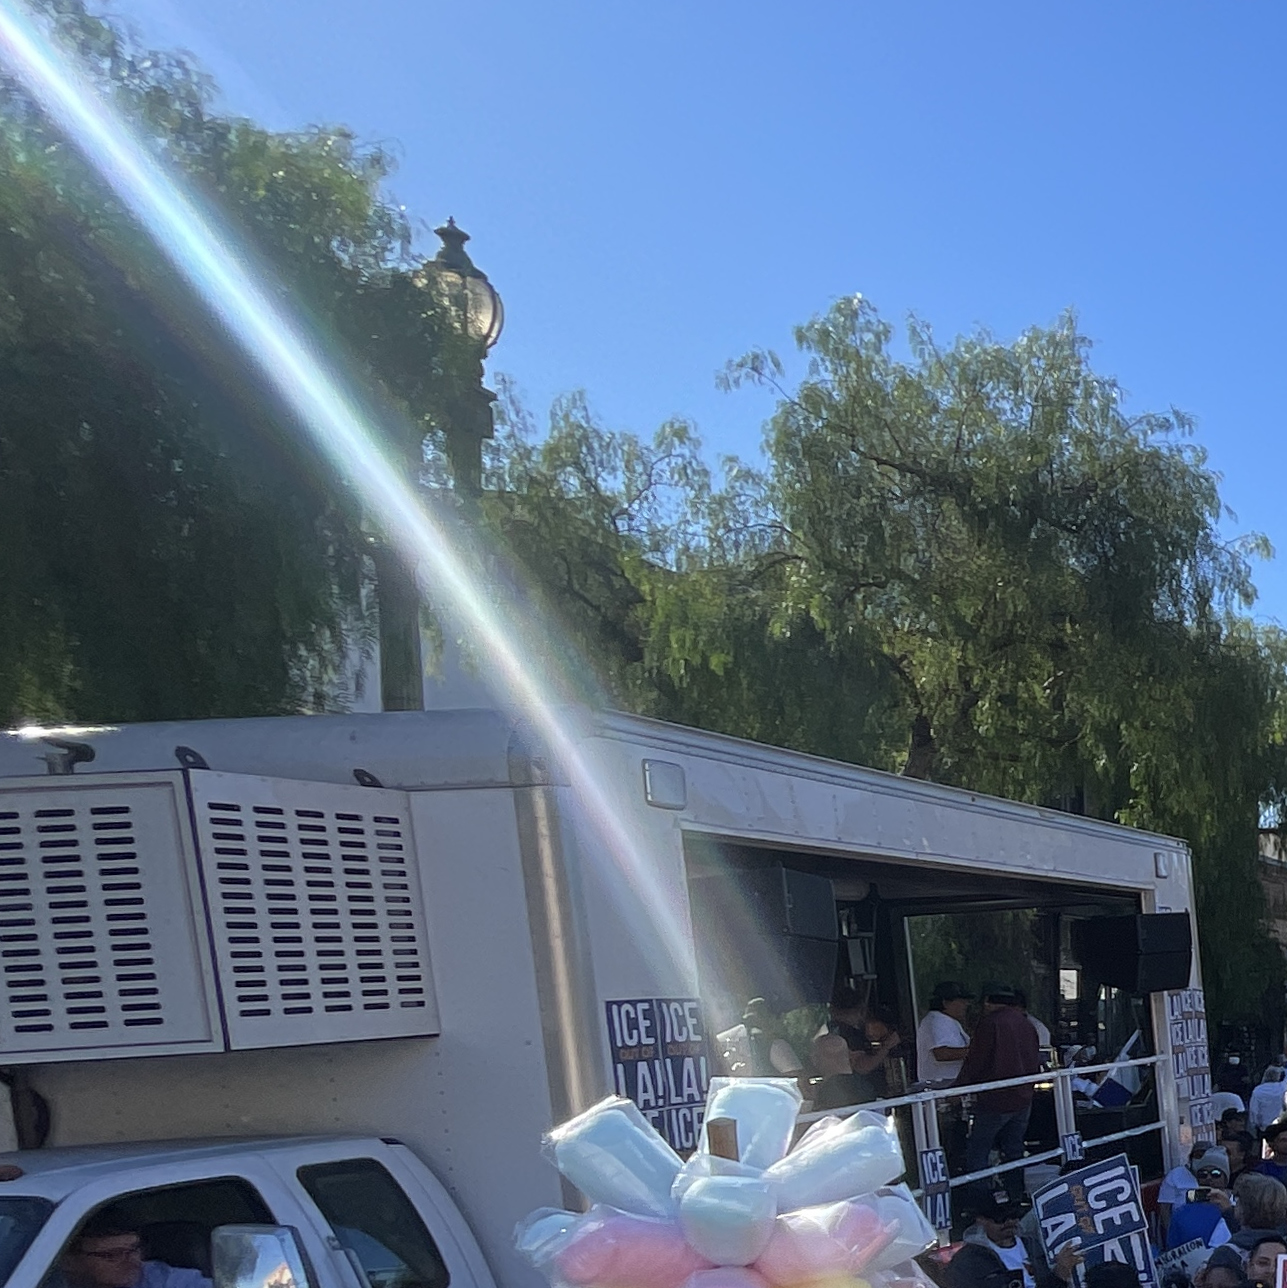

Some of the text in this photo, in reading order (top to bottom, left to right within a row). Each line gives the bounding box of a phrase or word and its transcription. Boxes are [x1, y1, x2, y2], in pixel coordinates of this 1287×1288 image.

[612, 1002, 655, 1047] ICE
[662, 1001, 703, 1042] ICE
[616, 1060, 664, 1108] LA!
[665, 1056, 708, 1102] LA!
[1083, 1166, 1141, 1235] ICE
